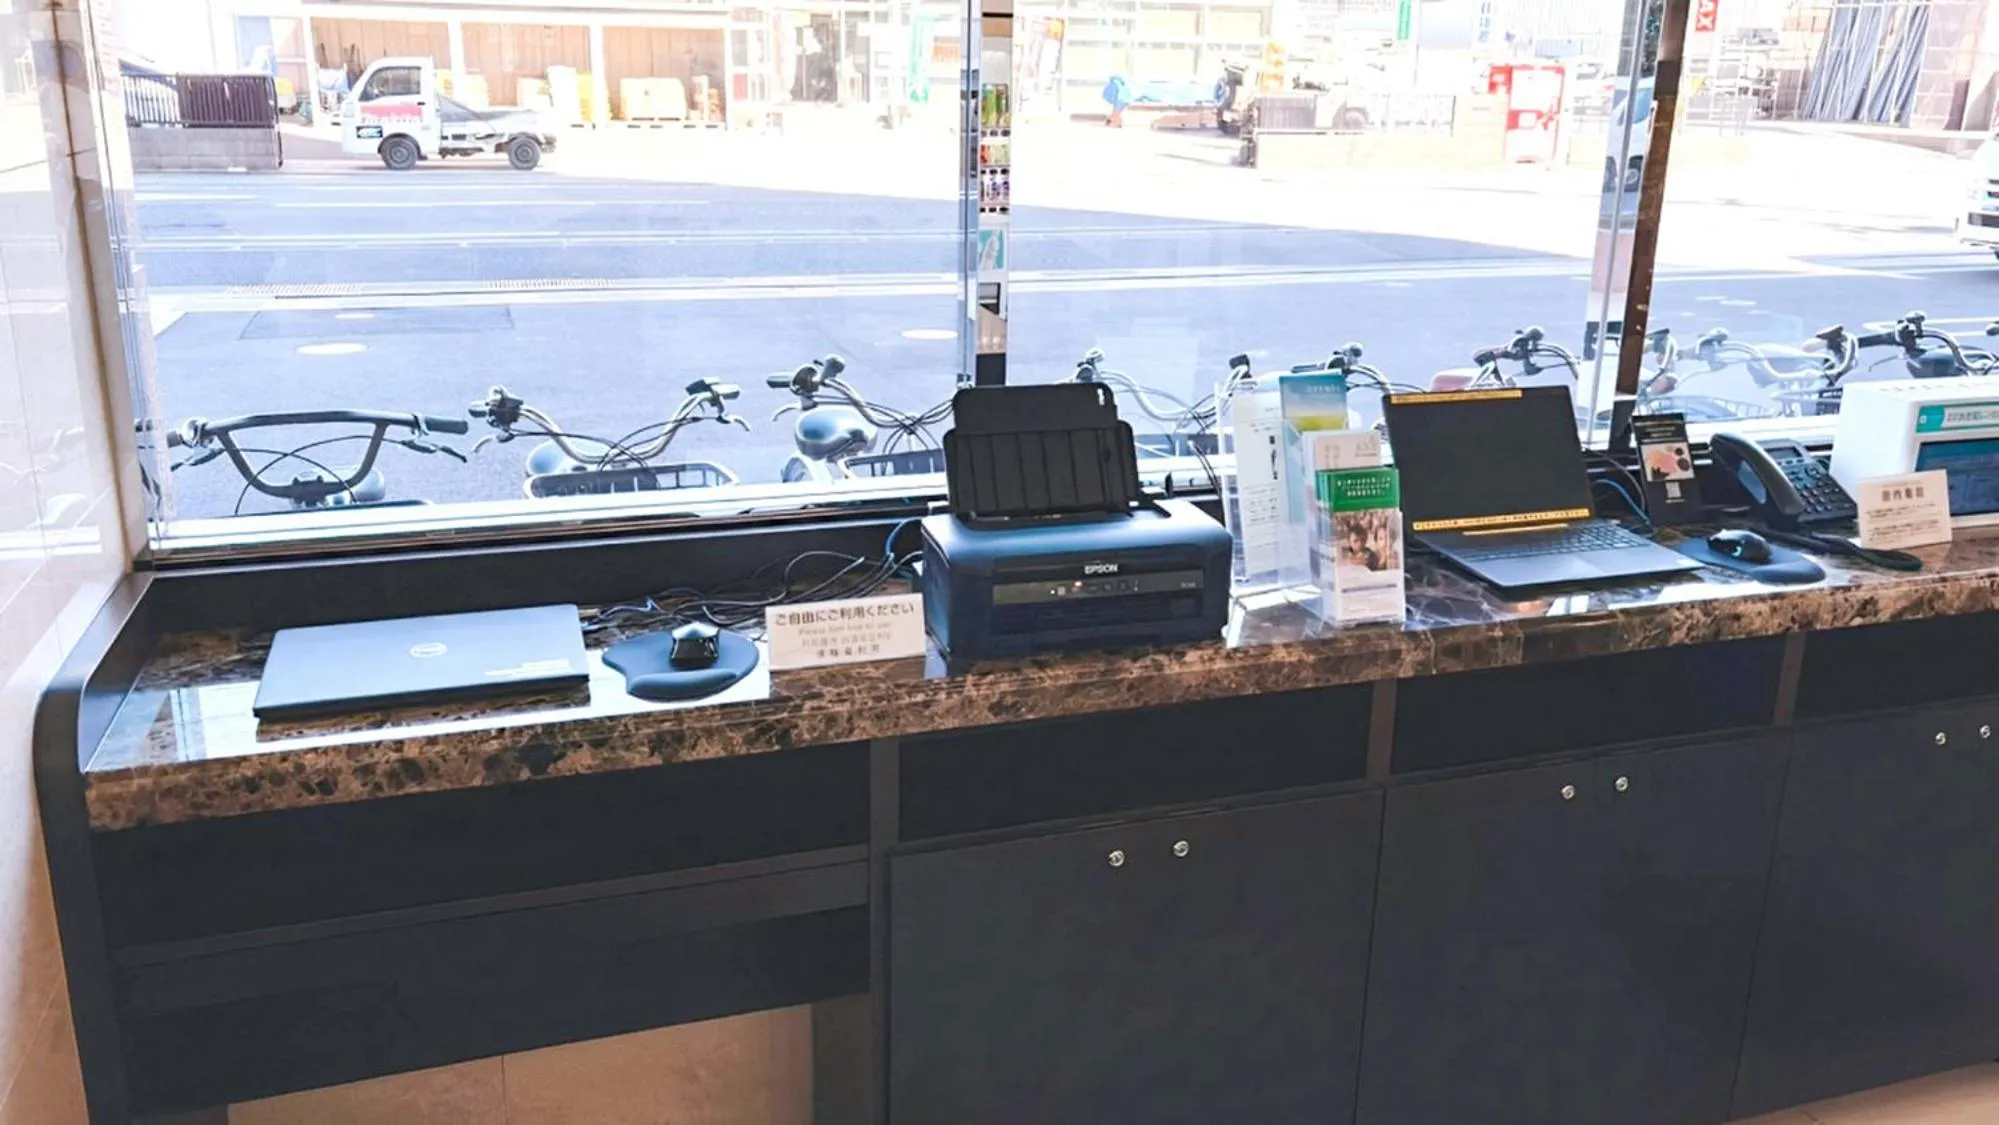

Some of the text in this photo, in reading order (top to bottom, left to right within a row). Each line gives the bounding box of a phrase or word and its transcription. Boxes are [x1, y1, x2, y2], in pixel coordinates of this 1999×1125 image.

[1084, 563, 1118, 575] EPSON
[775, 603, 914, 625] ご自由にご利用ください
